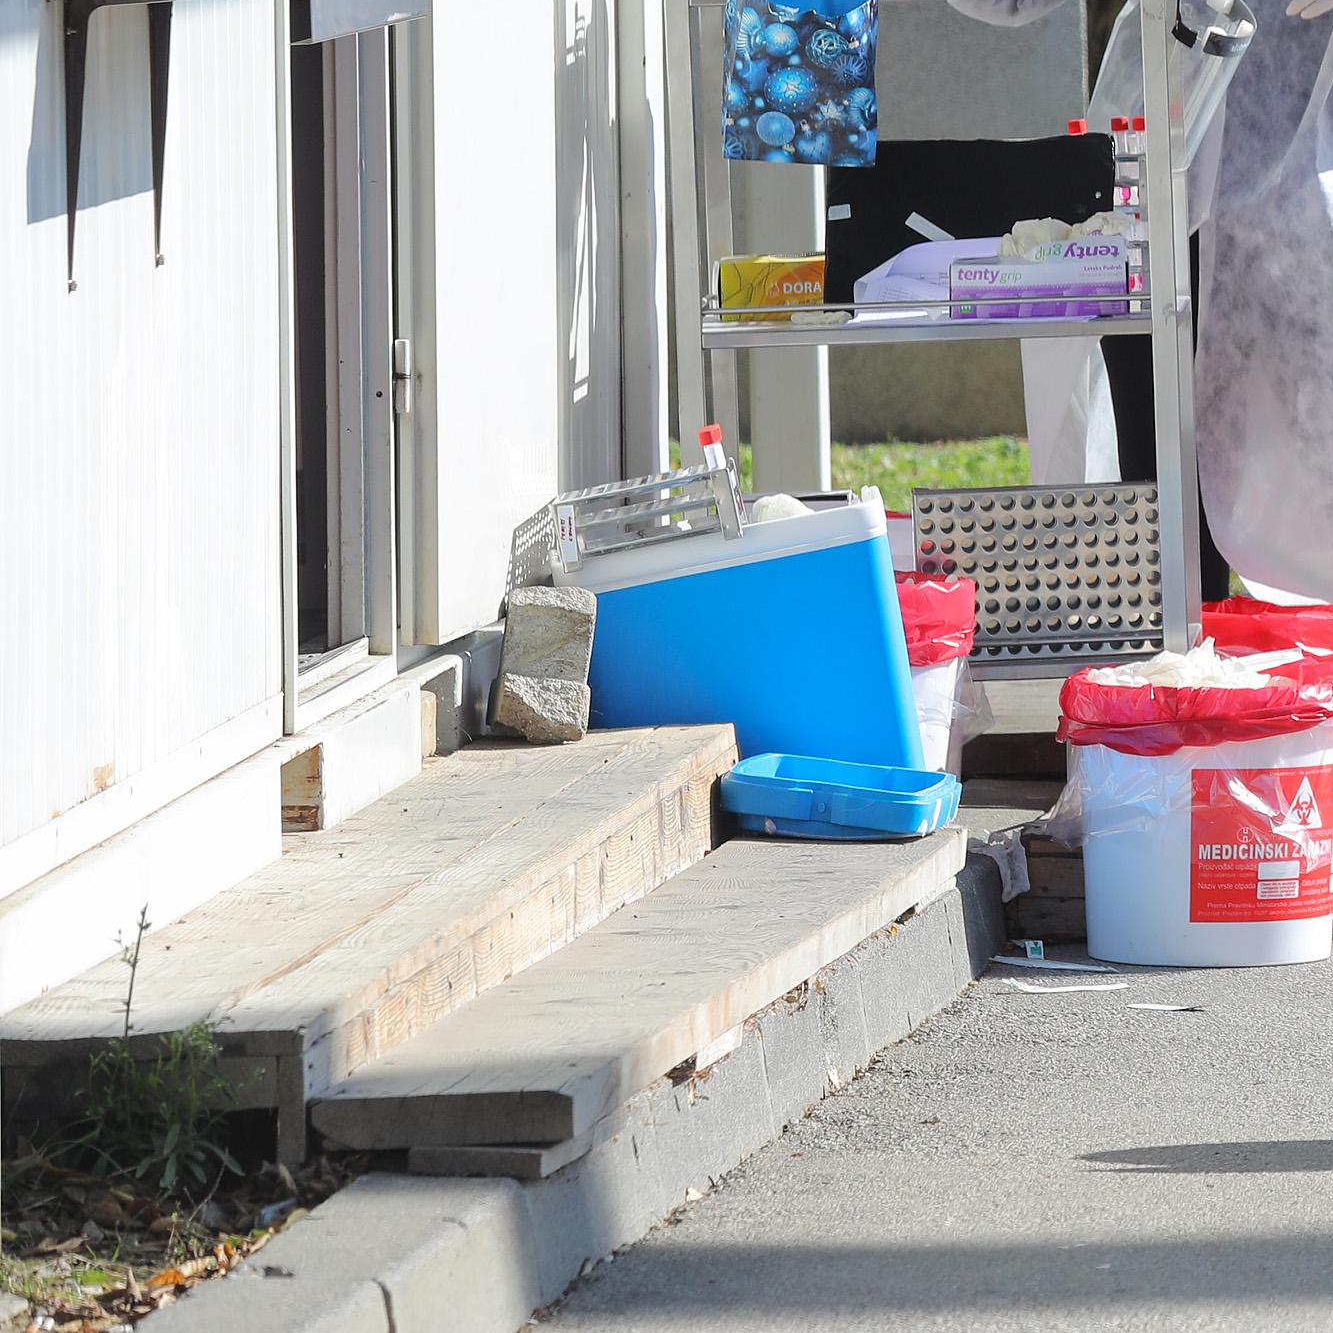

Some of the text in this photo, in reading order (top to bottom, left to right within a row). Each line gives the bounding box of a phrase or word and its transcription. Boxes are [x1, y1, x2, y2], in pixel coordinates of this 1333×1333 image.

[1034, 241, 1120, 261] tenty grip
[957, 267, 1023, 284] tenty grip
[782, 281, 823, 295] DORA
[1199, 842, 1289, 860] MEDICINSKI
